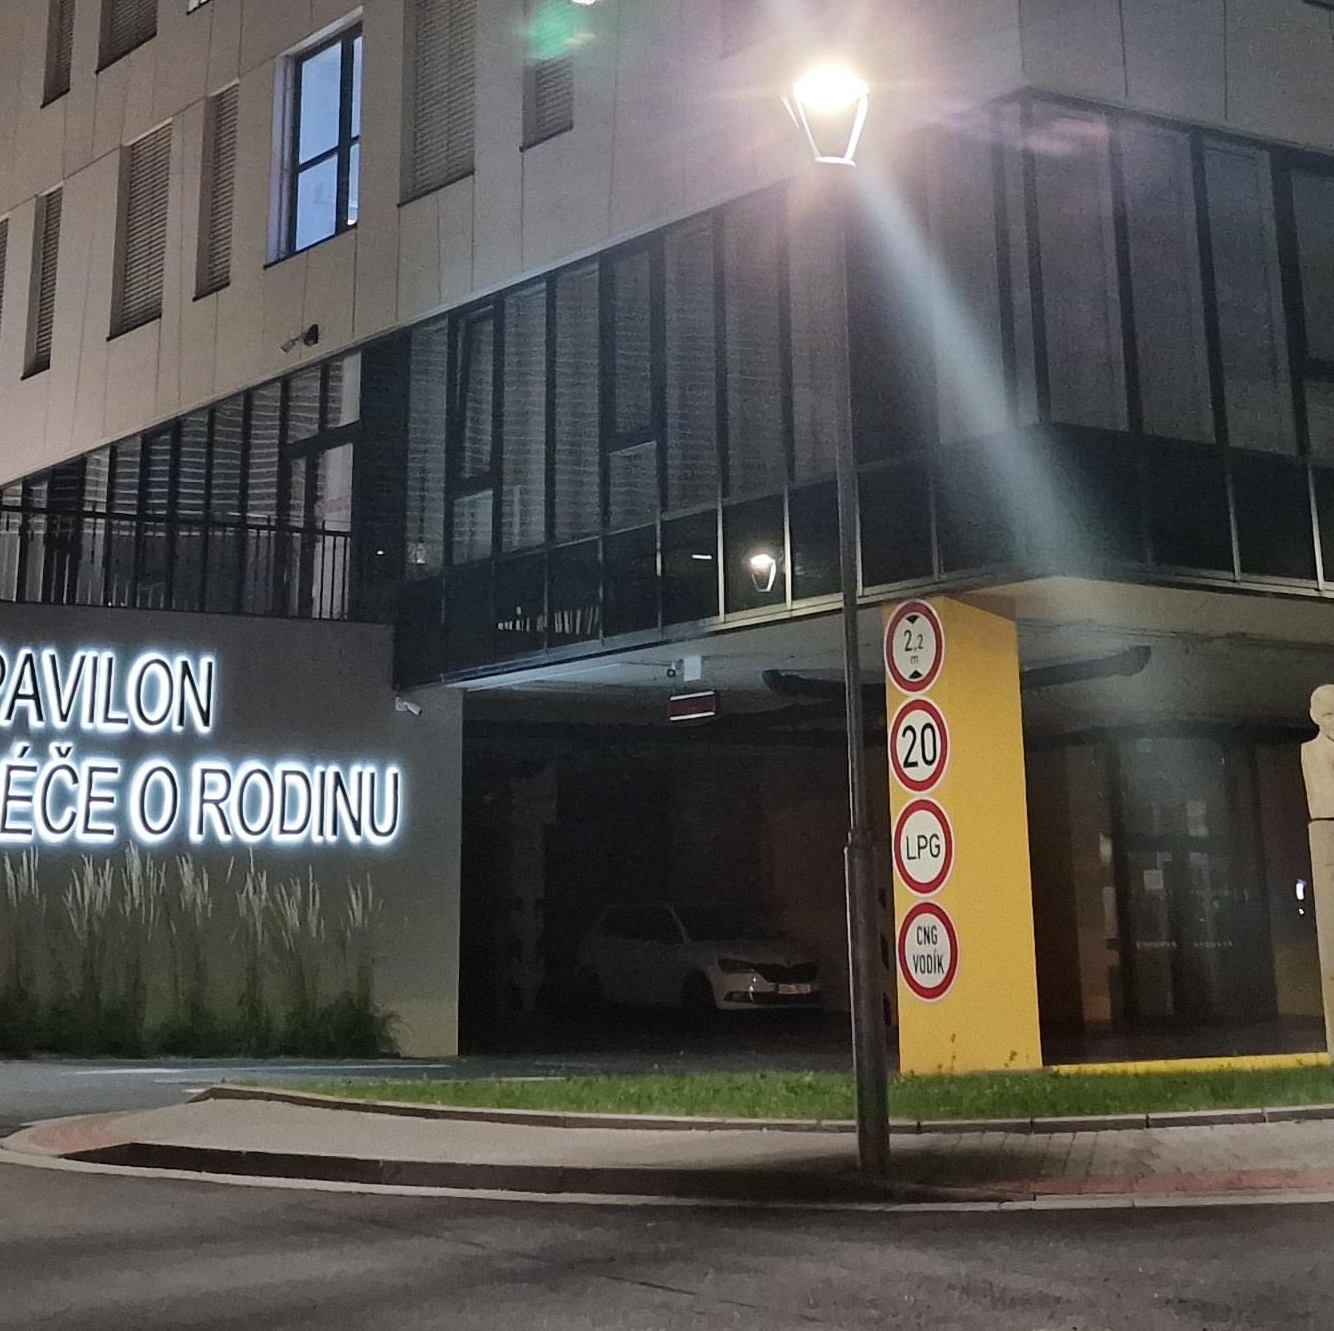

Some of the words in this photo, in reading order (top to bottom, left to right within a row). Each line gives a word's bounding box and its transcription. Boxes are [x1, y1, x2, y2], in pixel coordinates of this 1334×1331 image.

[901, 722, 937, 768] 20
[138, 765, 179, 836] O
[196, 767, 400, 838] RODINU
[906, 833, 941, 860] LPG
[916, 925, 938, 947] CNG
[912, 947, 945, 975] VODÍK
